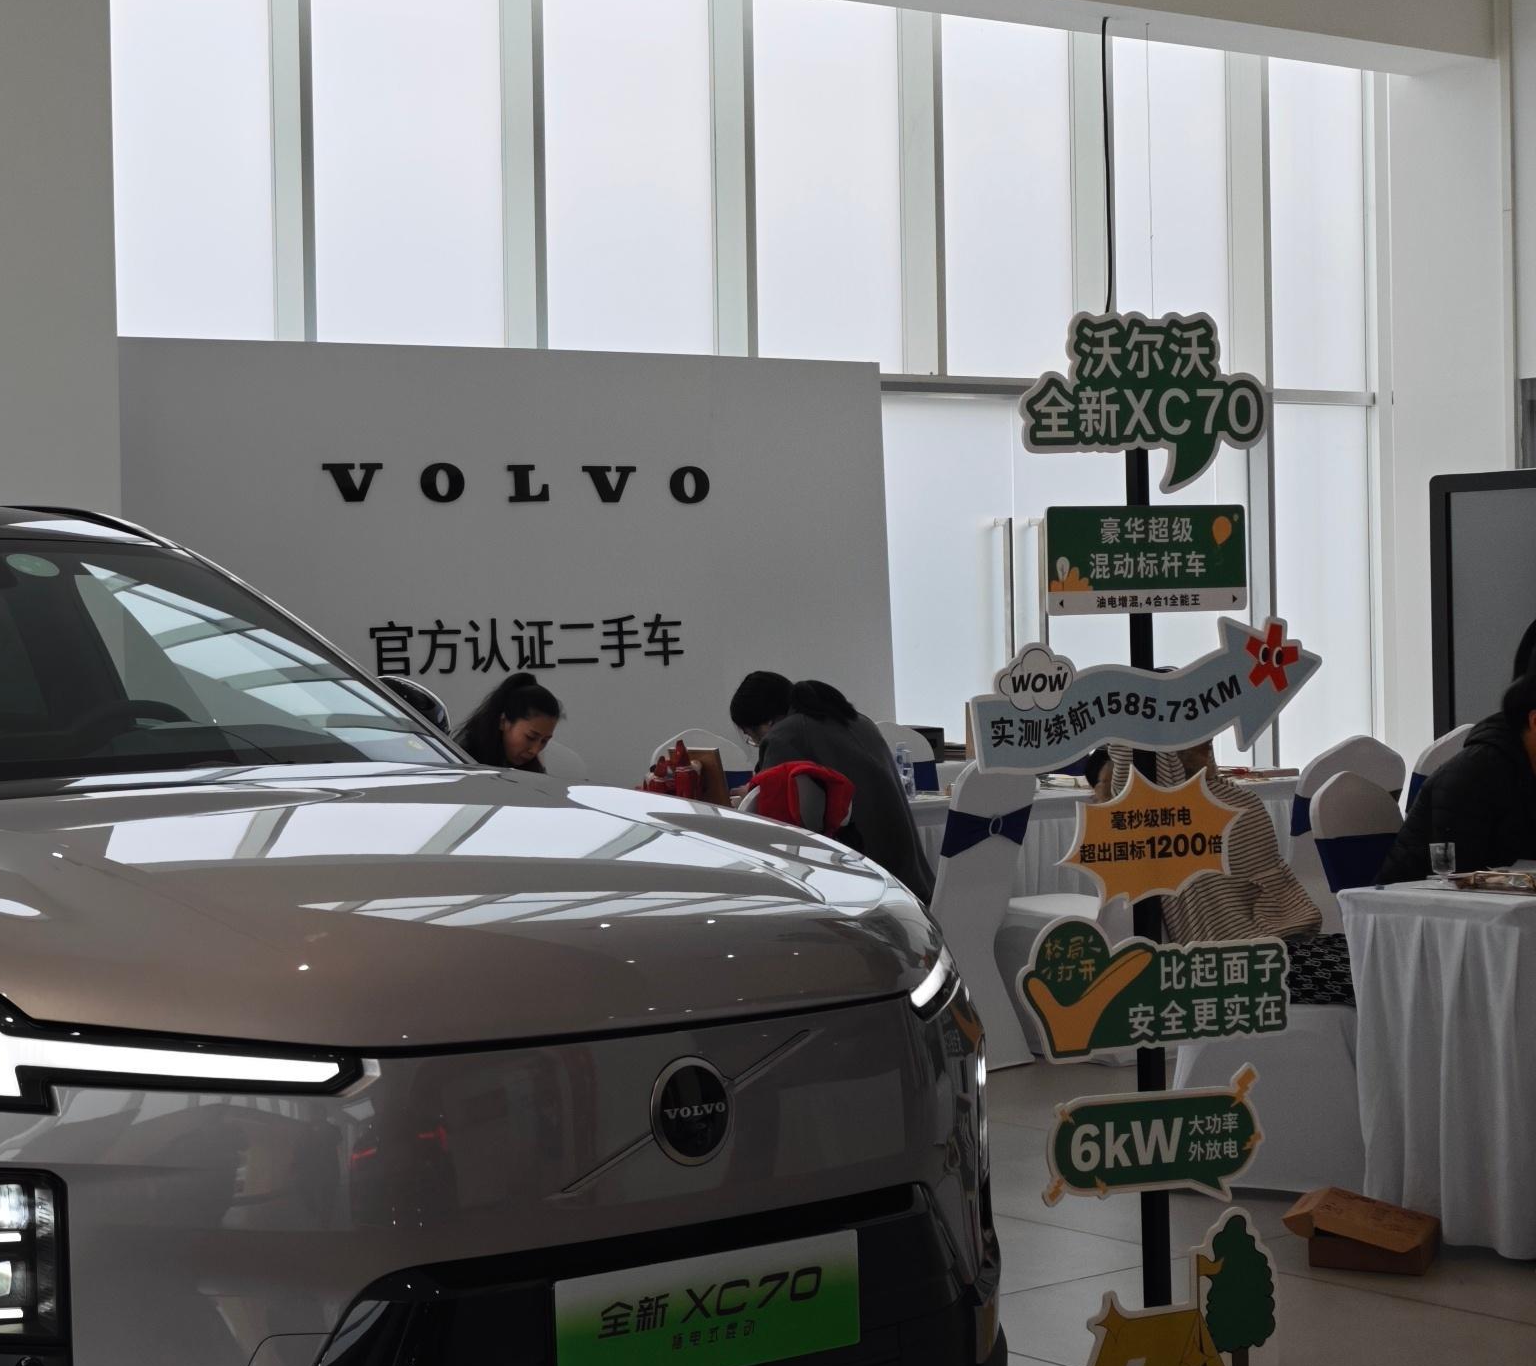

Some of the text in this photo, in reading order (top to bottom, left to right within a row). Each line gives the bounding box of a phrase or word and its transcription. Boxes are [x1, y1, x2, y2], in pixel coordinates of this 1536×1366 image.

[1080, 327, 1210, 379] 沃尔沃
[1033, 386, 1258, 439] 全新XC70
[321, 462, 711, 505] VOLVO
[1100, 516, 1194, 544] 豪华超级
[1089, 550, 1207, 579] 混动标杆车
[369, 613, 685, 677] 官方认证二手车
[1011, 671, 1068, 695] WOW
[990, 674, 1243, 749] 实测续航1585.73KM
[1110, 806, 1193, 831] 毫秒级断电
[1079, 832, 1223, 864] 超出国标1200倍
[1056, 958, 1096, 983] 打开
[1160, 949, 1281, 991] 比起面子
[1128, 991, 1283, 1039] 安全更实在
[664, 1101, 726, 1120] VOLVO
[1188, 1112, 1240, 1136] 大功率
[1070, 1117, 1184, 1172] 6kW
[1188, 1138, 1240, 1162] 外放电
[597, 1266, 823, 1340] 全新 XC70
